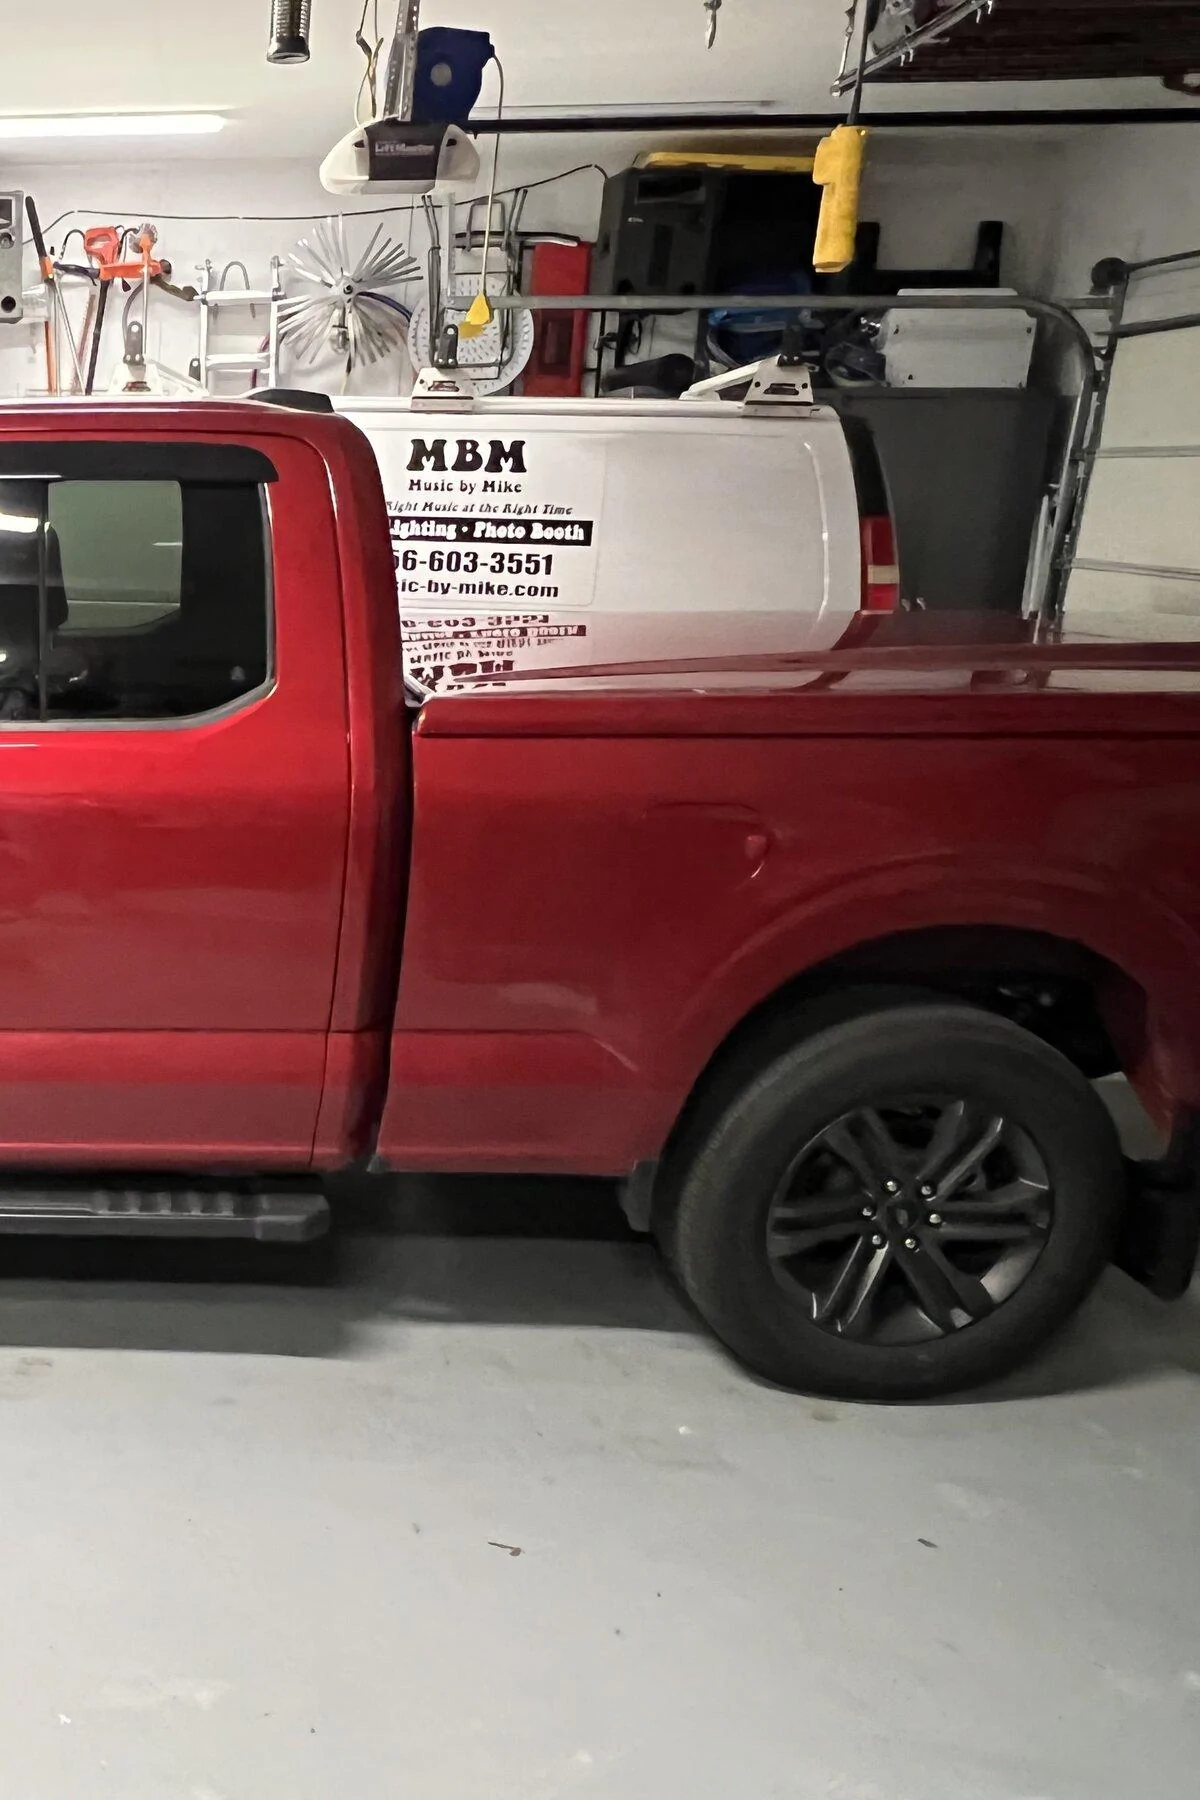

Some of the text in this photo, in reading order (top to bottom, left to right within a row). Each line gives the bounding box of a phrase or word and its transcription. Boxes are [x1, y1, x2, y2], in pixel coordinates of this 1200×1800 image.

[405, 438, 527, 473] MBM
[408, 479, 523, 495] Music by Mike
[421, 501, 458, 513] Music
[462, 502, 475, 513] at
[479, 502, 499, 514] the
[502, 503, 538, 516] Right
[542, 504, 573, 515] Time
[472, 521, 526, 539] Photo
[530, 522, 584, 541] Booth
